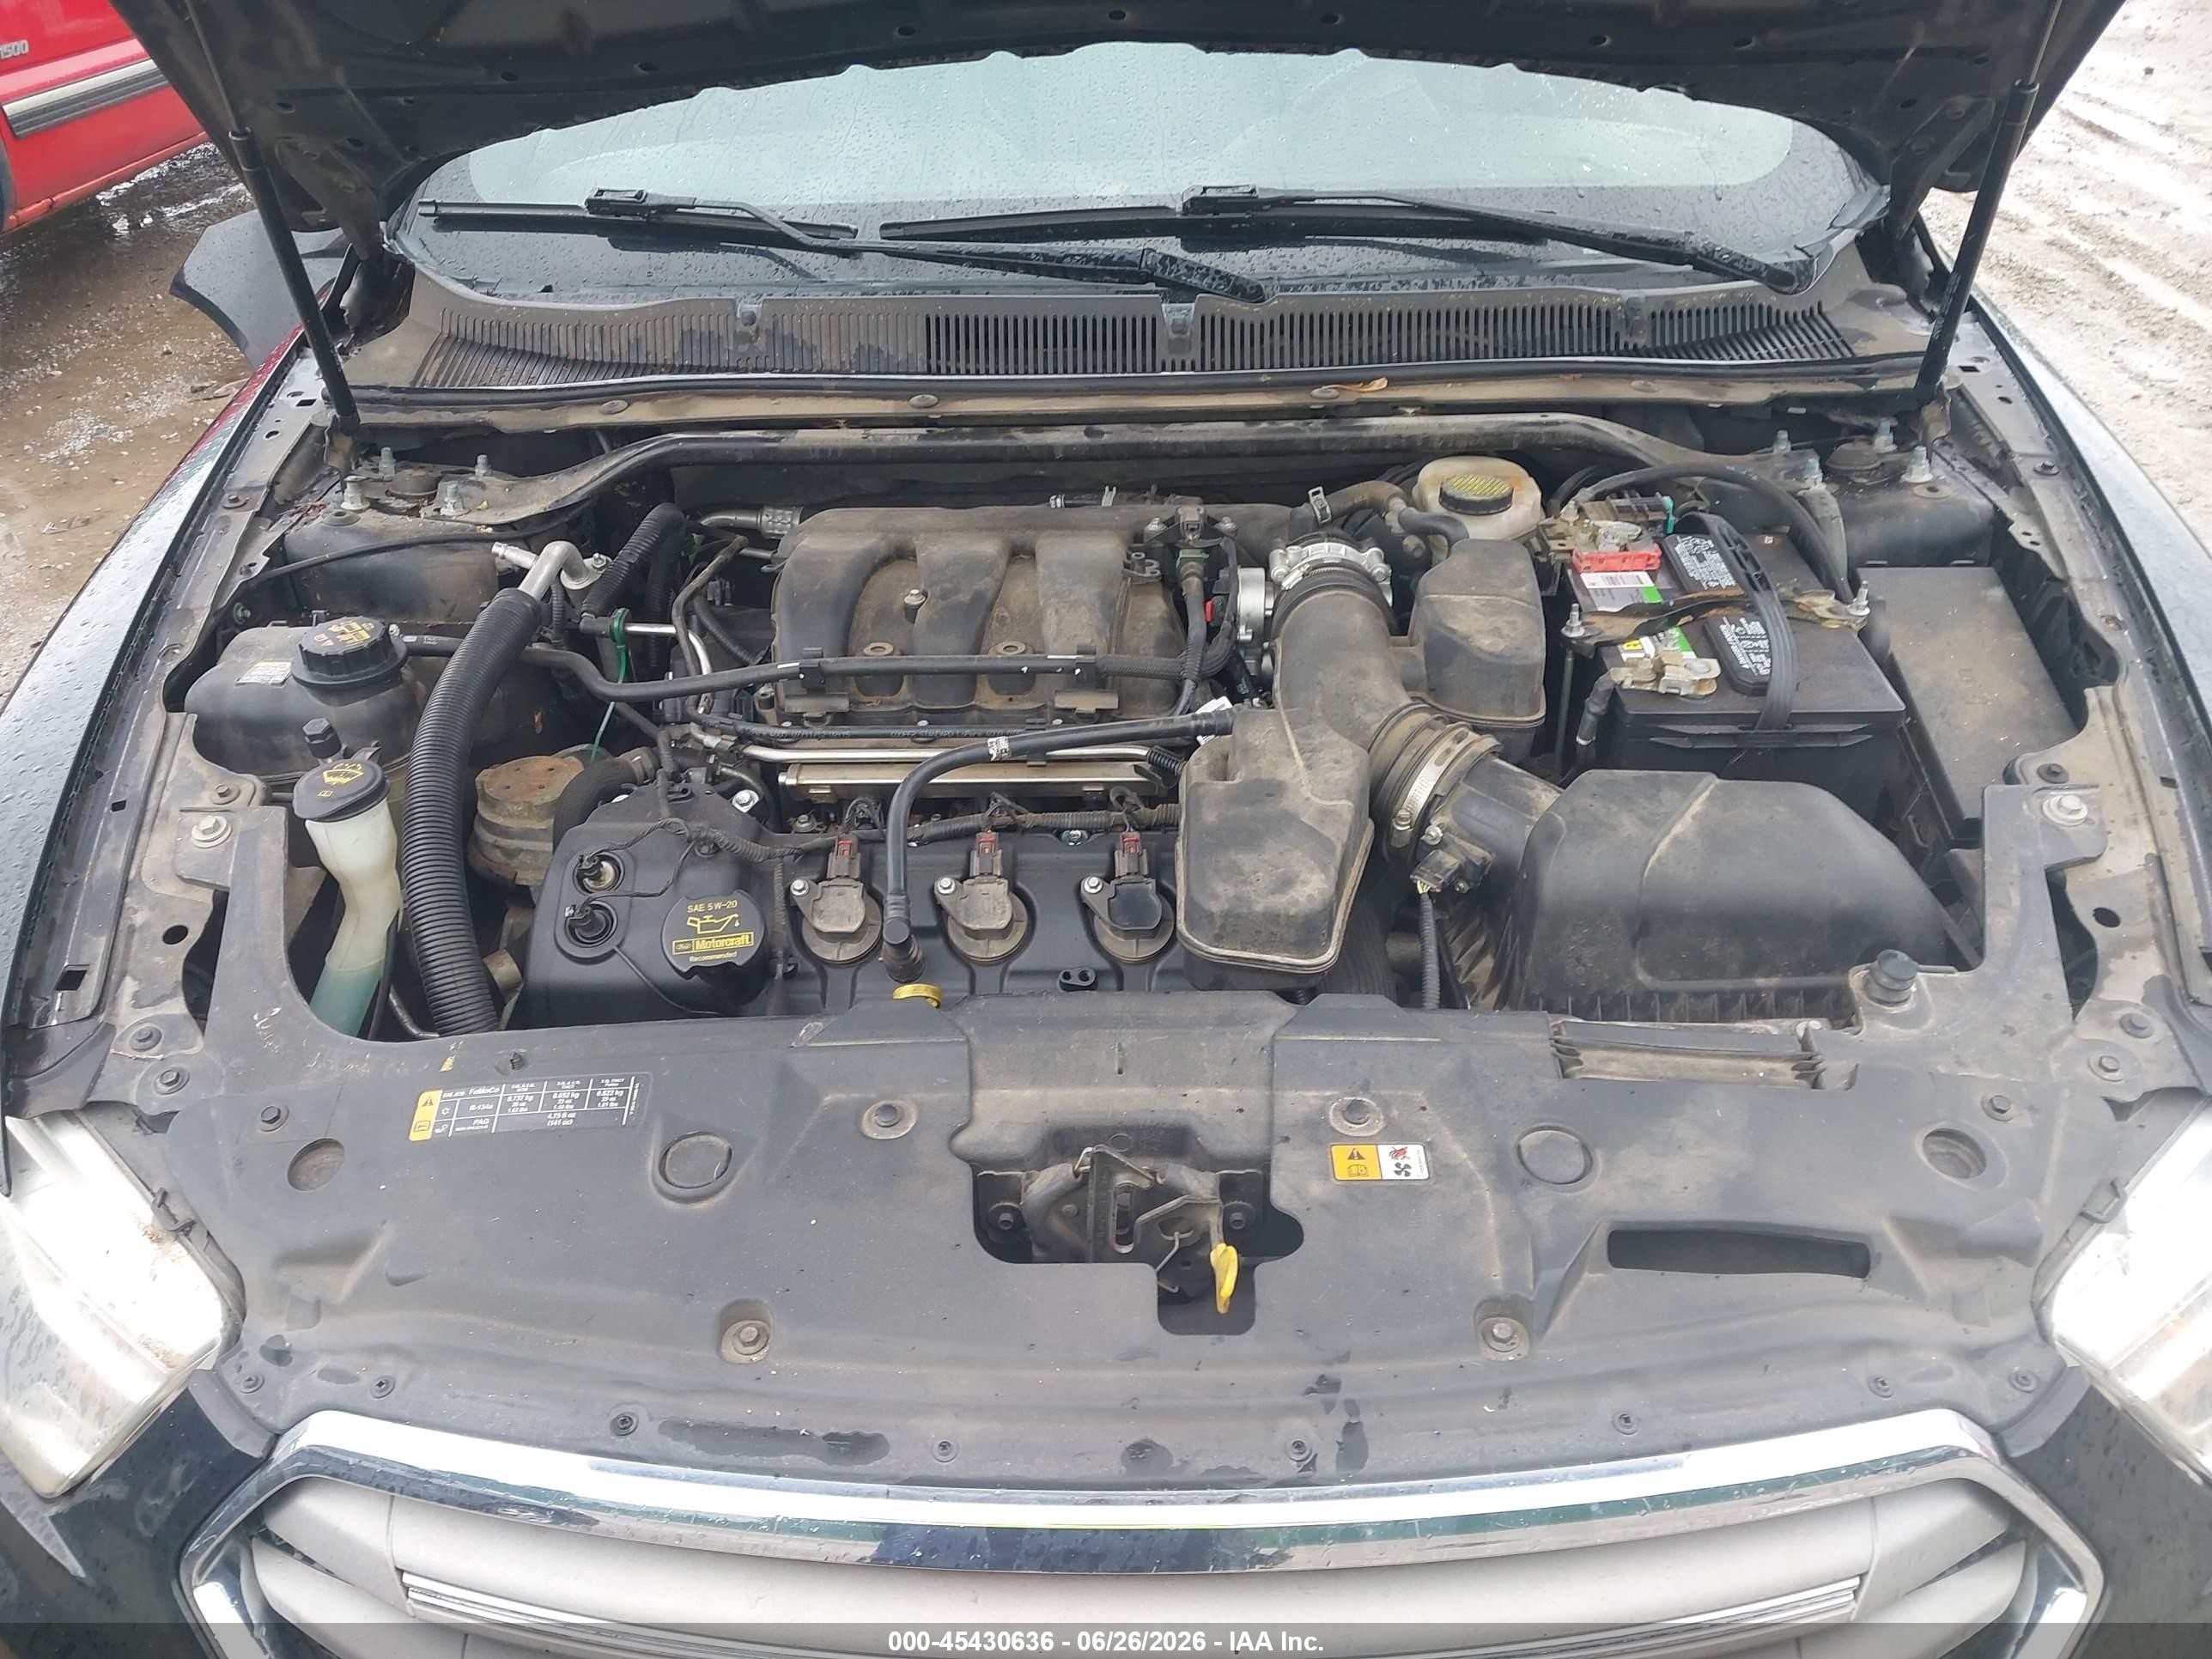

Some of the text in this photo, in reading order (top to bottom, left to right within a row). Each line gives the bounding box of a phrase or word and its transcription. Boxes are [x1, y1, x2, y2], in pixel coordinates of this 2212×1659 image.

[0, 40, 29, 59] 1500
[687, 902, 706, 913] SAE
[695, 934, 750, 950] Motorcraft
[689, 951, 738, 963] Recommended
[469, 1086, 501, 1096] FoMoCo
